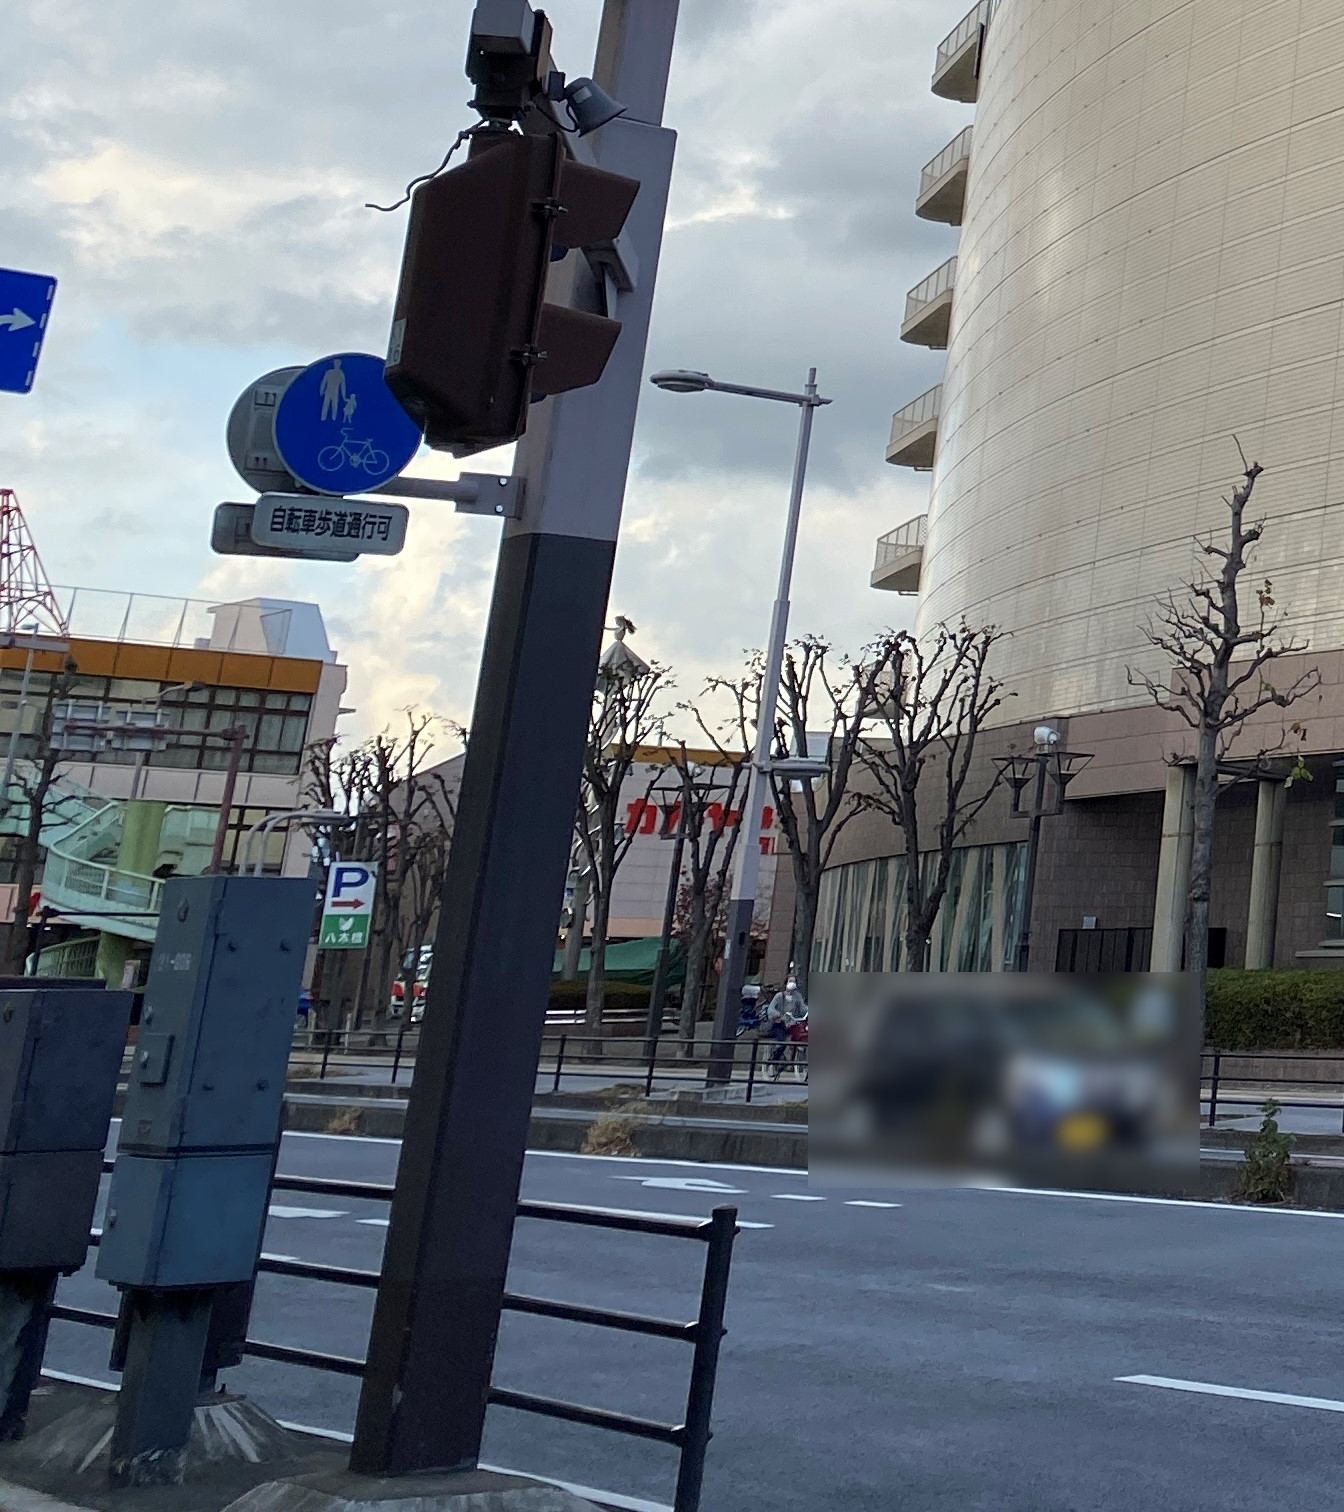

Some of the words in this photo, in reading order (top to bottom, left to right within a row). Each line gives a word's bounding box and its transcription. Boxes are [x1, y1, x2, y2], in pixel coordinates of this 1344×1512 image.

[270, 505, 393, 541] 自転車歩道通行可
[332, 867, 369, 898] P
